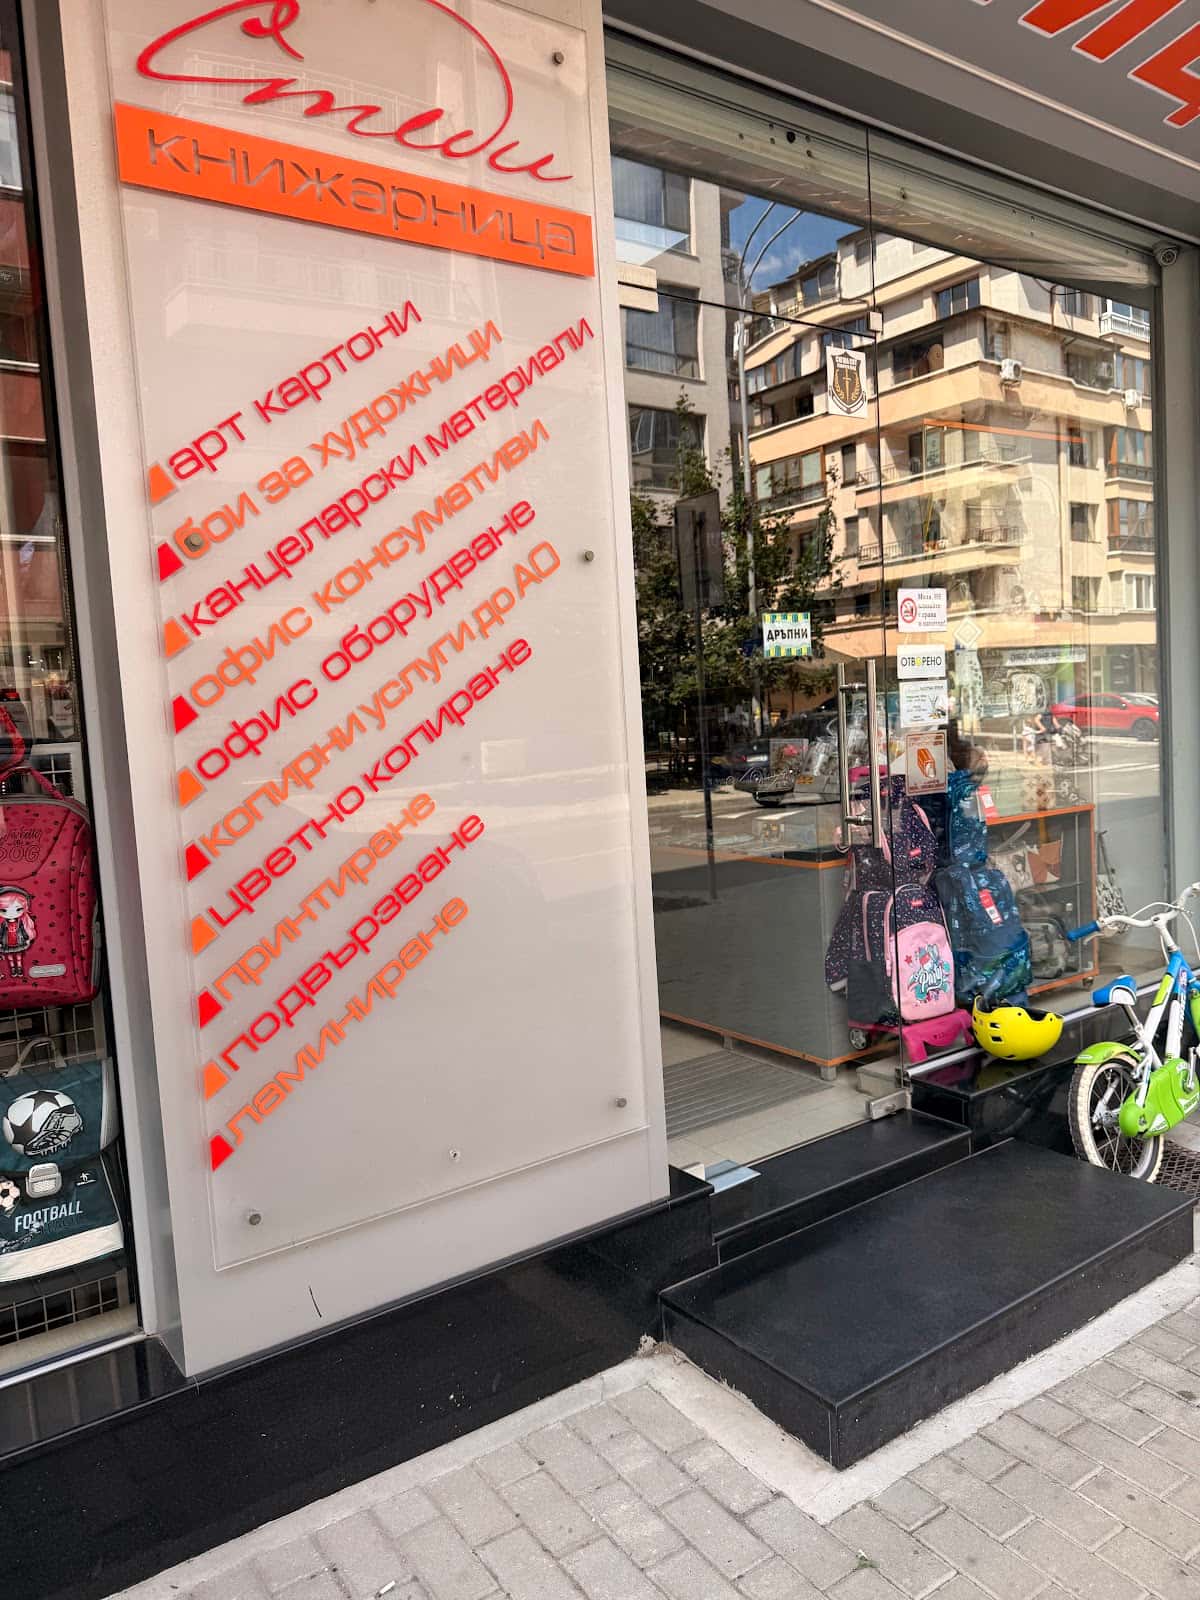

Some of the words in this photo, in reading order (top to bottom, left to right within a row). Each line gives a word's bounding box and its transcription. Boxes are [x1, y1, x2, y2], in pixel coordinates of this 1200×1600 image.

[147, 128, 577, 260] книжарница
[167, 411, 246, 481] арт
[253, 300, 422, 424] картони
[172, 491, 260, 560] бои
[257, 455, 314, 504] за
[310, 319, 502, 467] художници
[180, 444, 428, 637] канцеларски
[424, 318, 594, 457] материали
[190, 606, 313, 708] офис
[312, 419, 550, 614] консумативи
[195, 678, 319, 781] офис
[320, 500, 536, 683] оборудване
[767, 628, 808, 642] ДРЪПНИ
[900, 656, 942, 667] ОТВОРЕНО
[199, 712, 367, 858] копирни
[359, 620, 477, 730] услуги
[473, 586, 516, 639] до
[207, 784, 366, 929] цветно
[361, 638, 533, 793] копиране
[213, 793, 436, 1001] принтиране
[219, 814, 485, 1072] подвързване
[226, 897, 469, 1146] ламиниране
[14, 1200, 84, 1233] FOOTBALL
